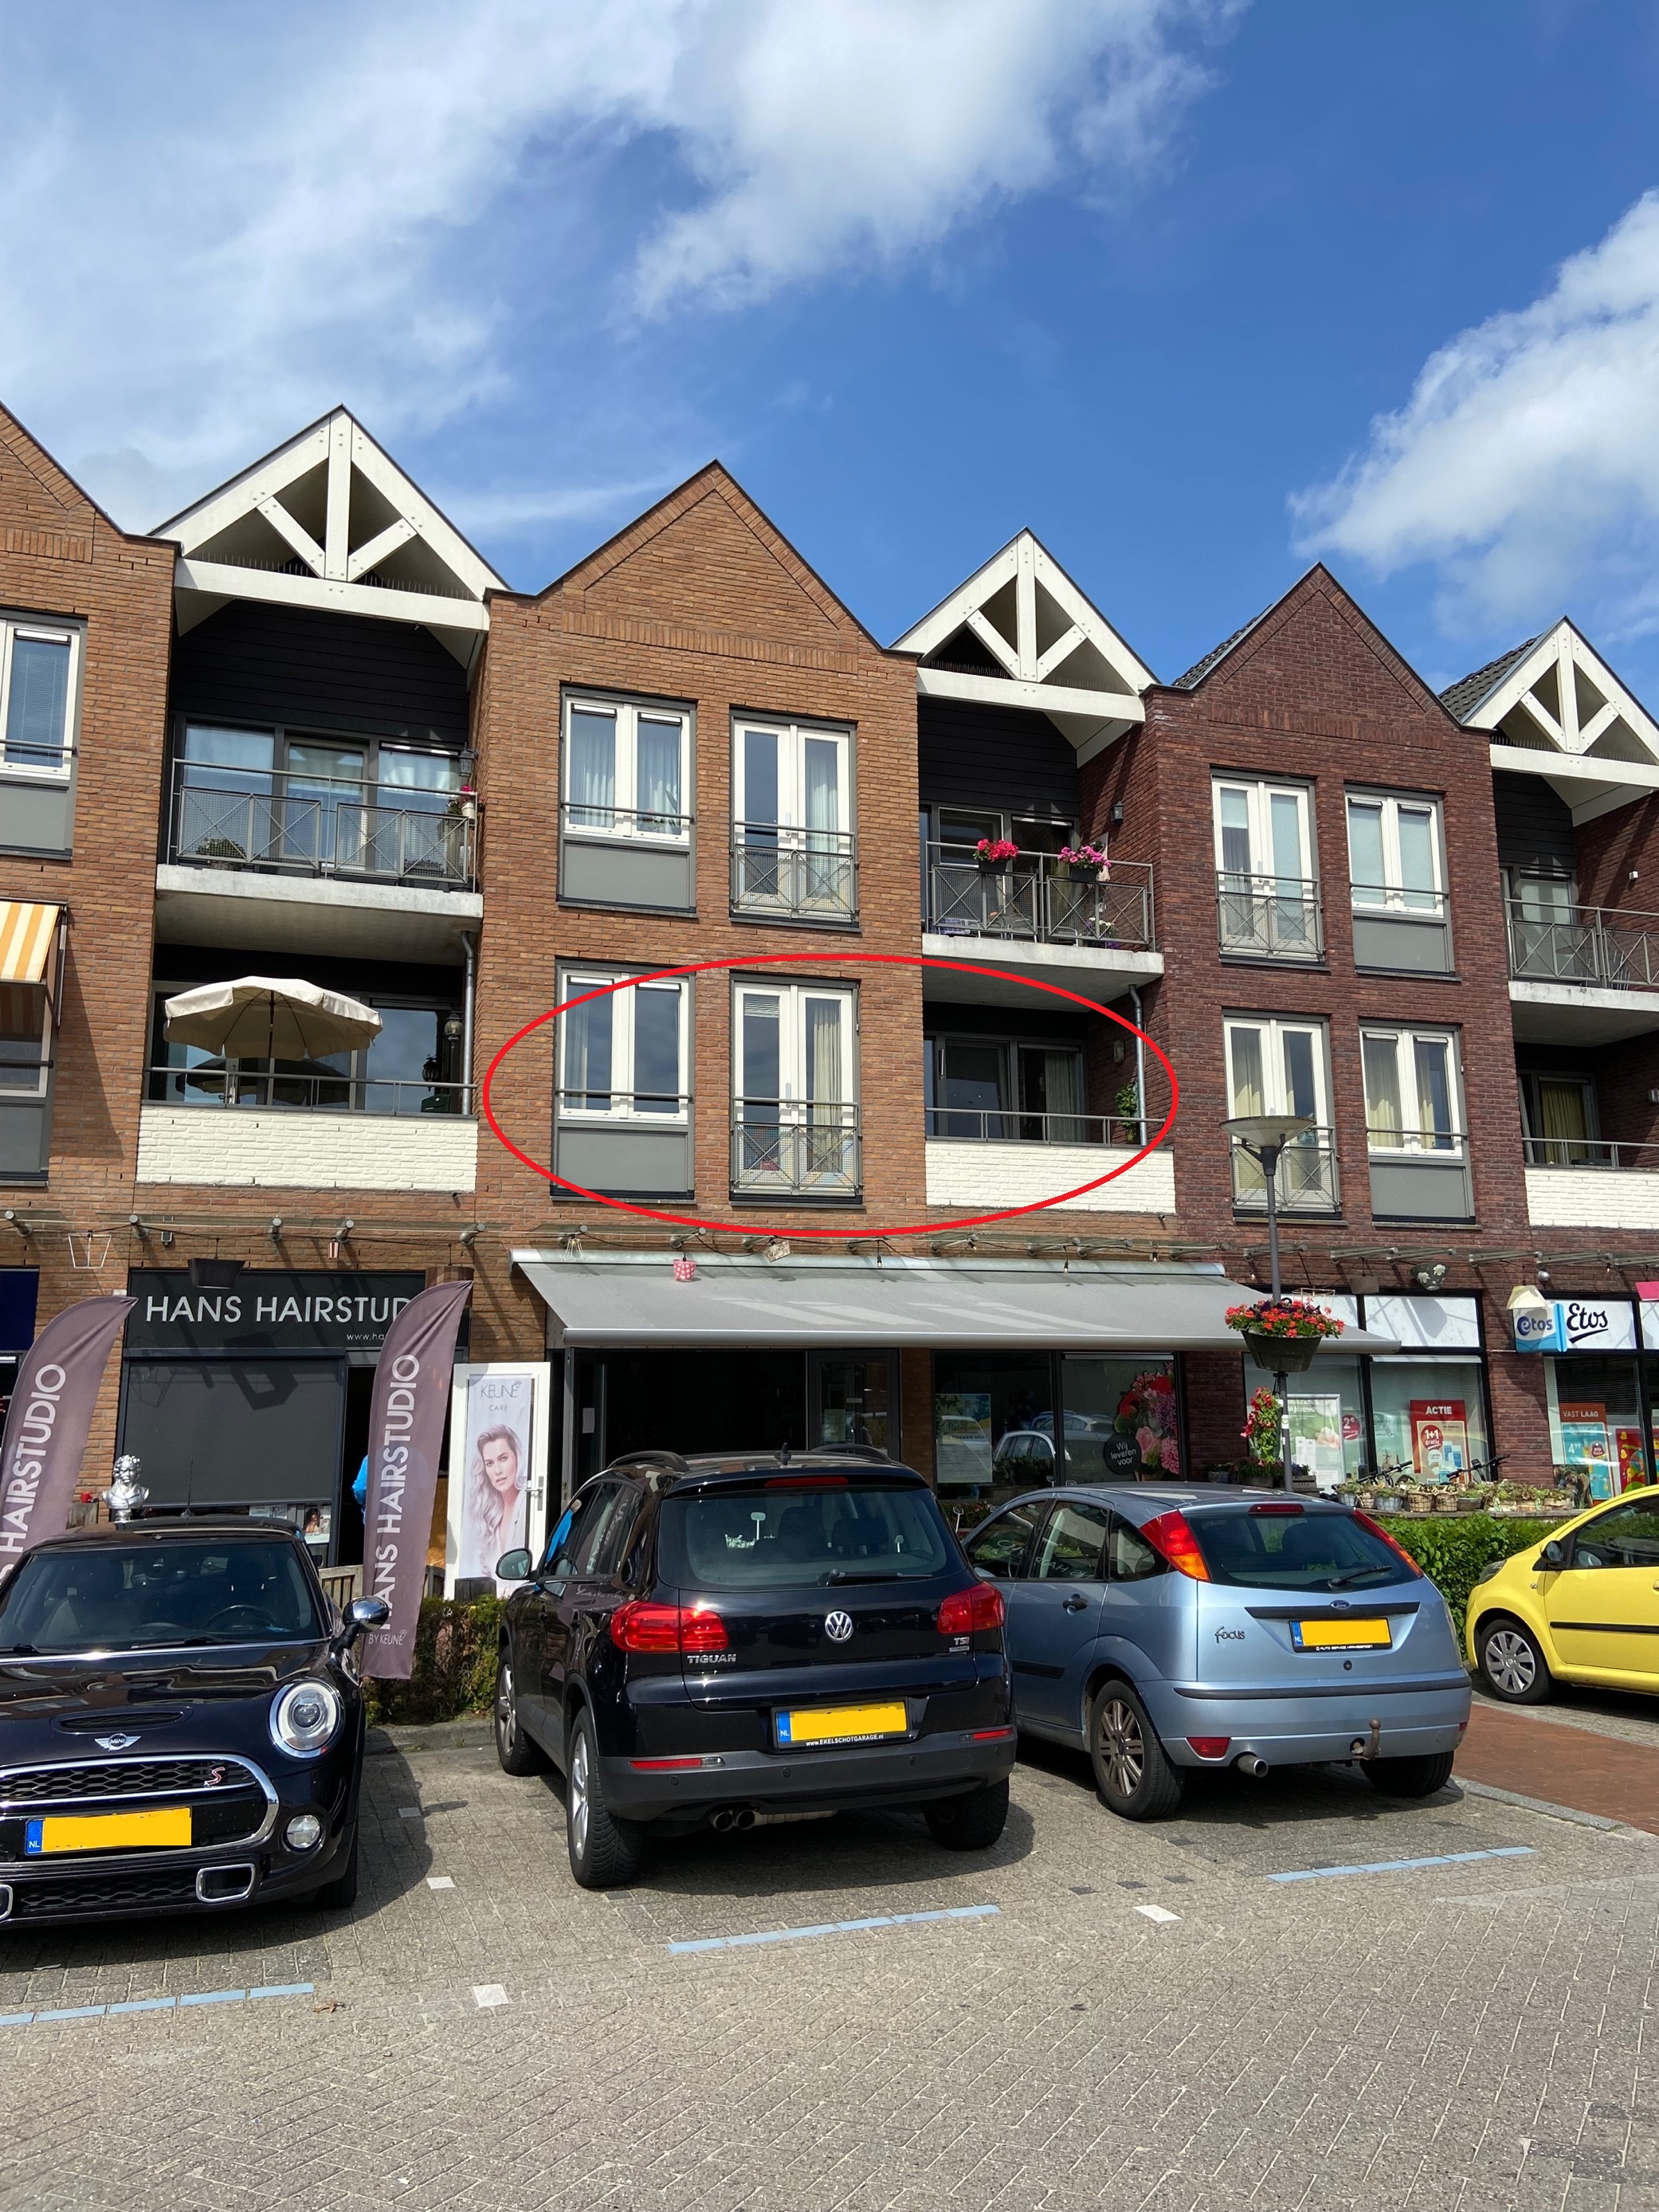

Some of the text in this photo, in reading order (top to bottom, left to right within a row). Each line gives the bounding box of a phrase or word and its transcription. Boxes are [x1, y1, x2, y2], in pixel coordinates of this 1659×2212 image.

[147, 1296, 242, 1323] HANS
[1566, 1302, 1609, 1332] Etos
[1516, 1316, 1553, 1336] etos
[480, 1384, 518, 1398] KEUNE
[1426, 1406, 1453, 1415] ACTIE
[1425, 1429, 1440, 1440] 1+1
[377, 1354, 420, 1534] HAIRSTUDIO
[1116, 1441, 1128, 1450] Wij
[0, 1364, 66, 1553] HAIRSTUDIO
[1110, 1449, 1137, 1460] leveren
[1116, 1457, 1133, 1466] voor
[368, 1634, 403, 1645] BY KEUNE
[687, 1653, 737, 1664] TIGUAN
[806, 1734, 884, 1747] www.EKELSCHOTGARAGE.nl
